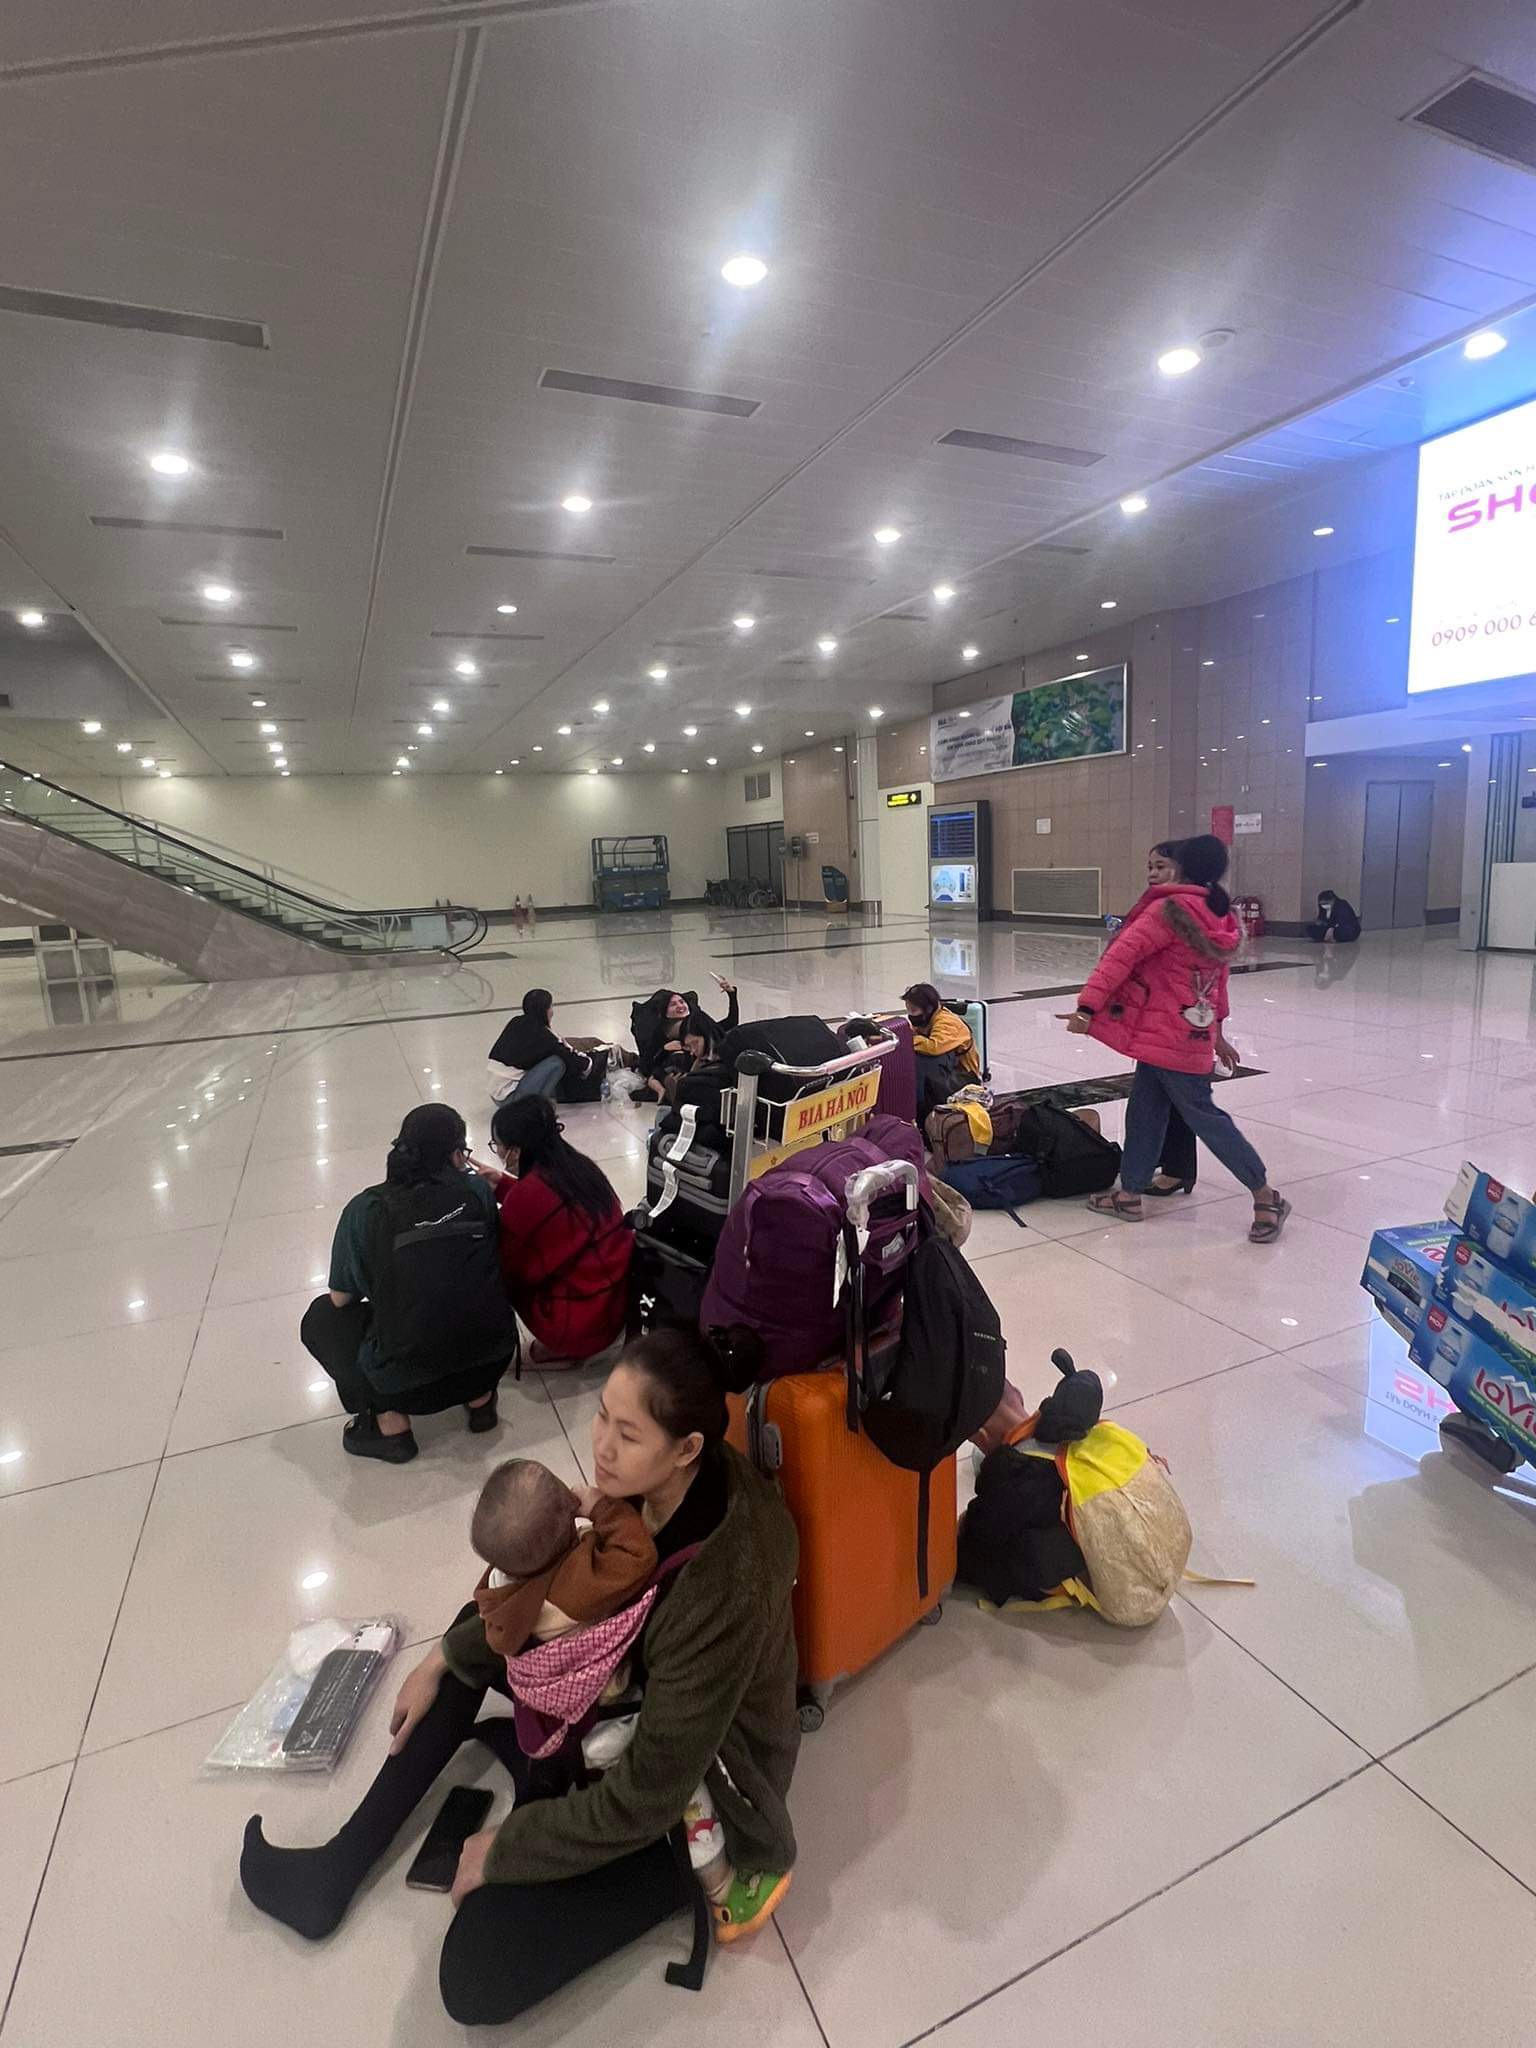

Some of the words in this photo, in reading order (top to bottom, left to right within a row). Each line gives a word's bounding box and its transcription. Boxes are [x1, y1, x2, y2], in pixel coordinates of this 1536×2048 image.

[1447, 483, 1536, 534] SH
[1431, 623, 1478, 647] 0909
[1484, 614, 1522, 636] 000
[798, 1103, 823, 1130] BIA
[846, 1082, 869, 1110] NỘI
